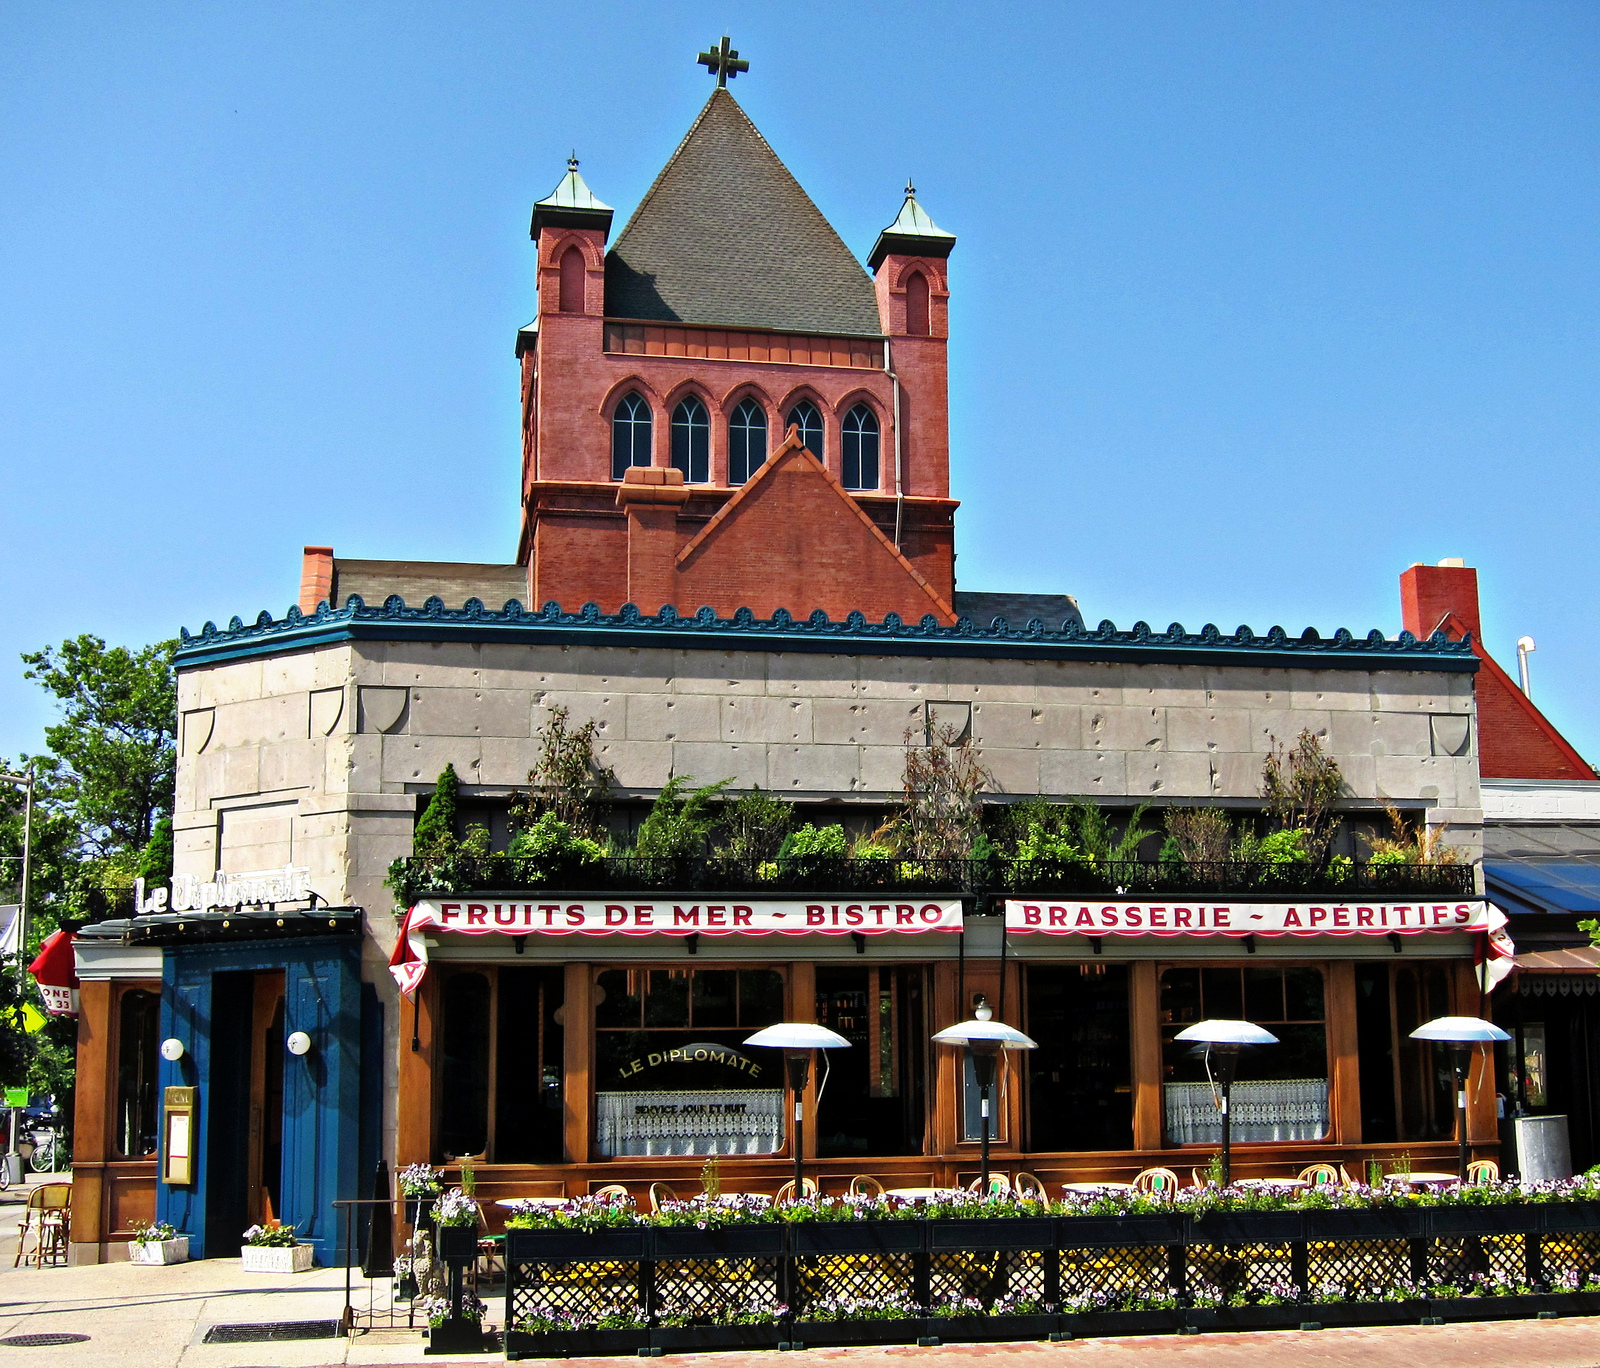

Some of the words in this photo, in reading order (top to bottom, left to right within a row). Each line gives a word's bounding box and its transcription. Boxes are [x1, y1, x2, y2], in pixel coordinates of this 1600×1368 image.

[134, 876, 168, 914] Le
[170, 863, 311, 913] Diplomate
[440, 903, 585, 926] FRUITS
[605, 904, 654, 926] DE
[673, 905, 753, 926] MER
[805, 903, 943, 926] BISTRO
[1023, 905, 1232, 927] BRASSERIE
[1283, 903, 1471, 927] APÉRITIFS
[42, 988, 70, 998] ONE
[56, 1000, 70, 1009] 33
[619, 1059, 645, 1079] LE
[648, 1049, 763, 1078] DIPLOMATE
[635, 1104, 678, 1115] SERVICE
[680, 1104, 706, 1115] JOUR
[708, 1104, 722, 1114] ET
[724, 1103, 747, 1114] NUIT
